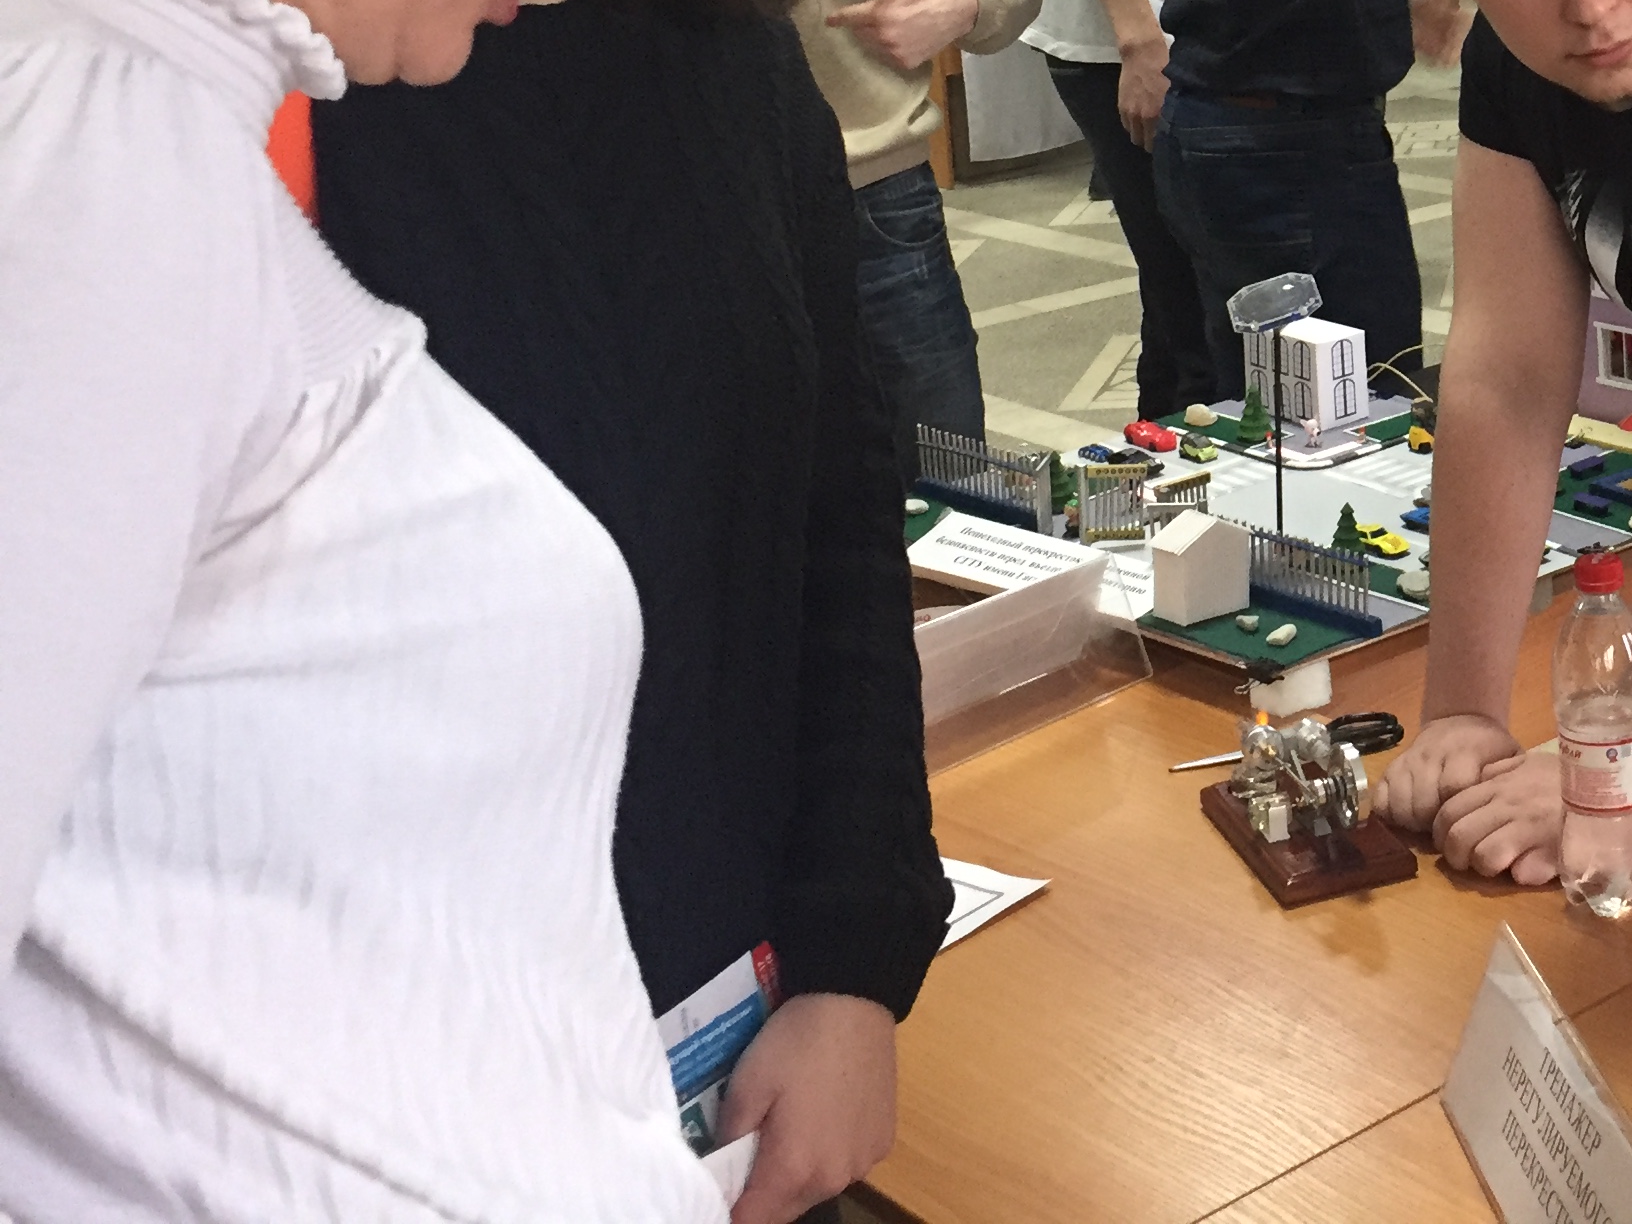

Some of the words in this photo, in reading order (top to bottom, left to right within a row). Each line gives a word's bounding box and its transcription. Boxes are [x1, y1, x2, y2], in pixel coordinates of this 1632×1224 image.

[953, 554, 986, 568] СГТУ
[1539, 1046, 1602, 1156] ТРЕНАЖЕР
[1502, 1109, 1576, 1224] ПЕРЕКРЕСТ
